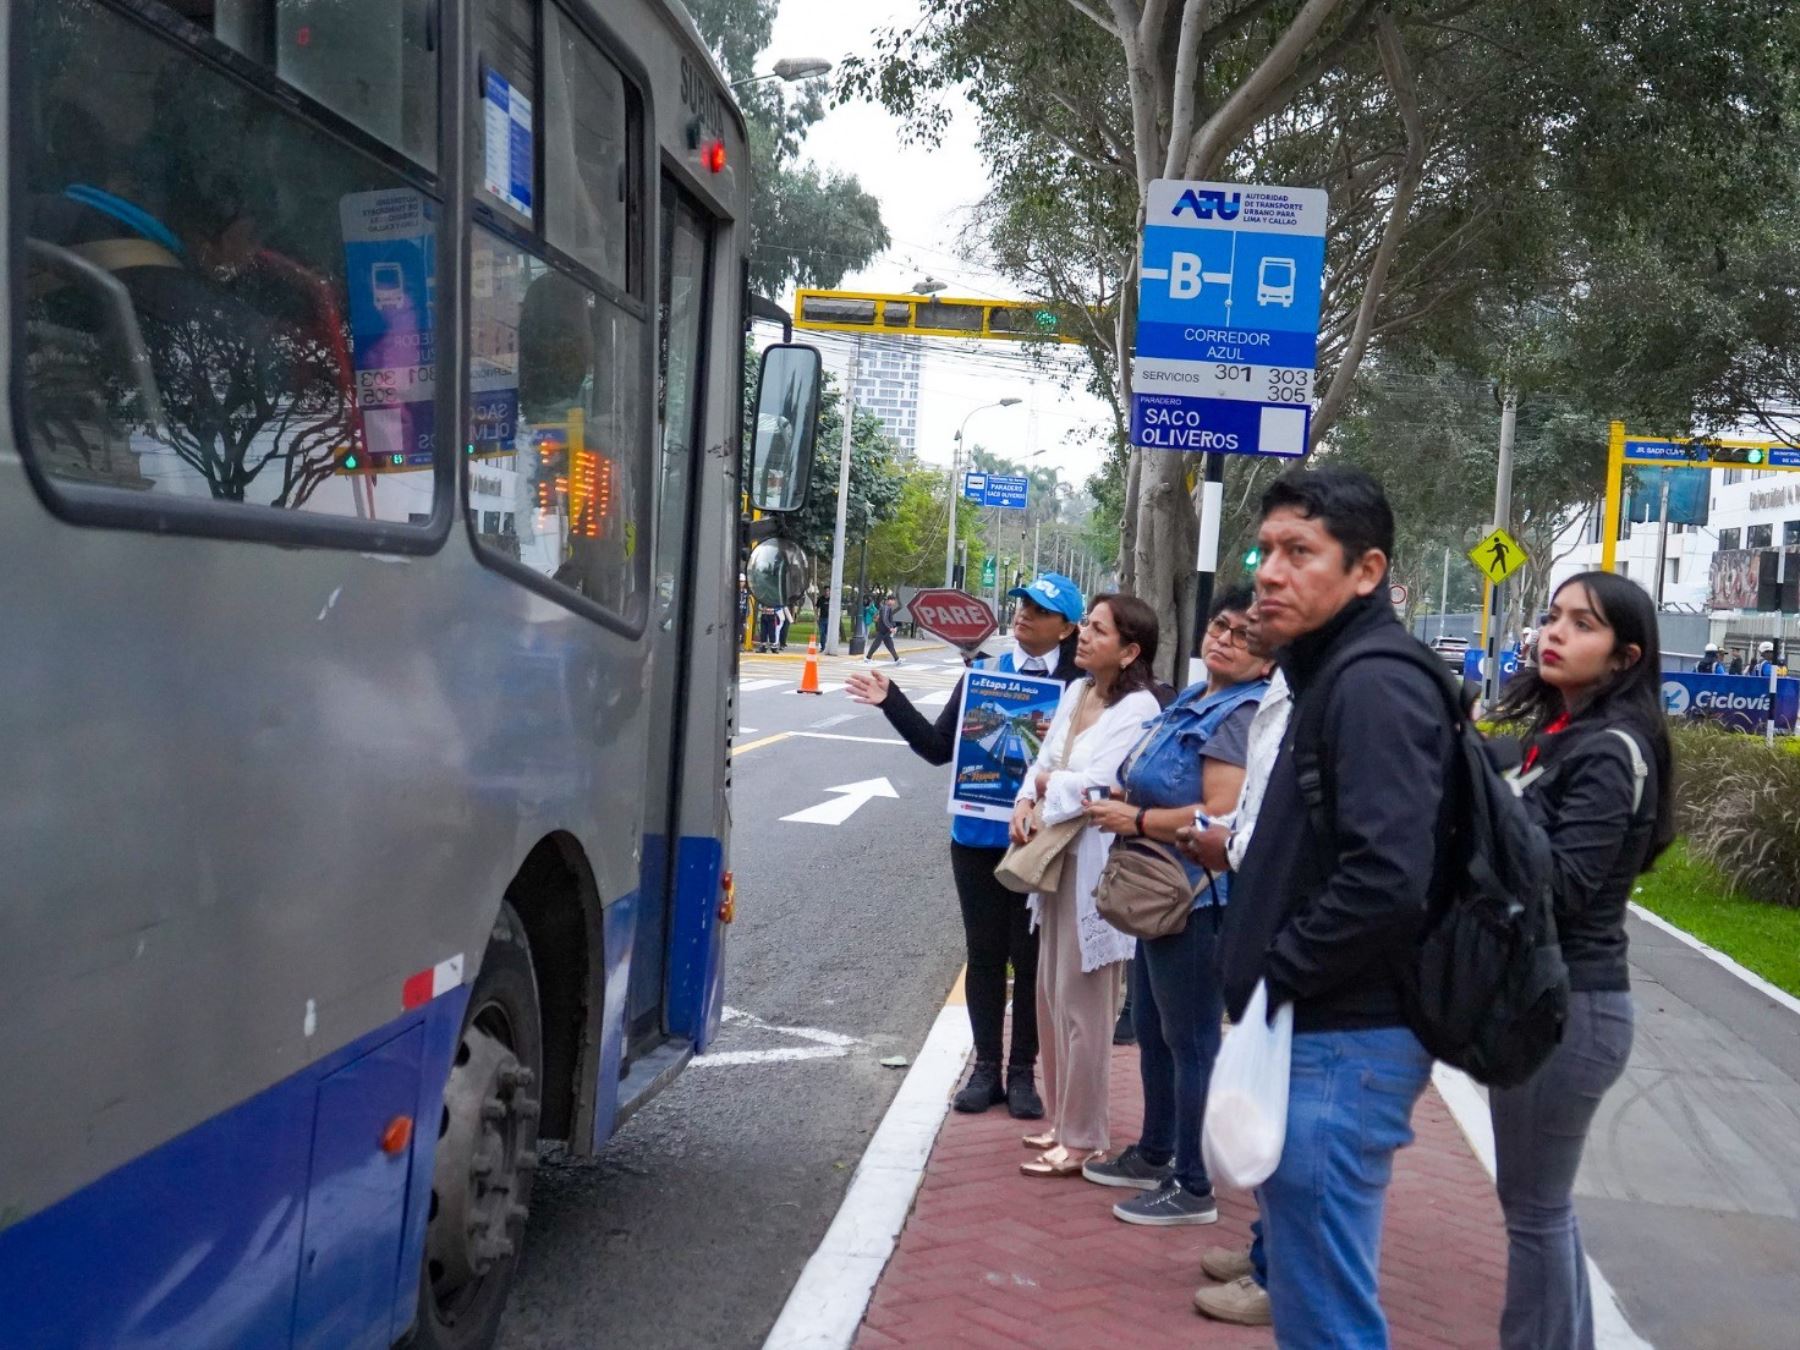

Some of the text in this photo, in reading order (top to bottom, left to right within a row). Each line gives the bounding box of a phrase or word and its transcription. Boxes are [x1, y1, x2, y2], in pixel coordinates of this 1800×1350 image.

[1171, 188, 1241, 220] ATU
[1245, 193, 1289, 201] AUTORIDAD
[1243, 208, 1295, 218] URBANO PARA
[1244, 200, 1303, 211] DE TRANSPORTE
[1243, 215, 1297, 226] LIMA Y CALLAO
[1169, 251, 1202, 300] B
[1184, 328, 1270, 346] CORREDOR
[1206, 346, 1245, 360] AZUL
[1142, 364, 1308, 386] SERVICIOS 301 303
[1140, 396, 1181, 406] PARADERO
[1267, 386, 1306, 403] 305
[1145, 408, 1200, 427] SACO
[1141, 428, 1239, 450] OLIVEROS
[991, 483, 1023, 492] PARADERO
[918, 605, 986, 626] PARE
[980, 677, 1007, 691] Etapa
[1008, 681, 1021, 691] 1A
